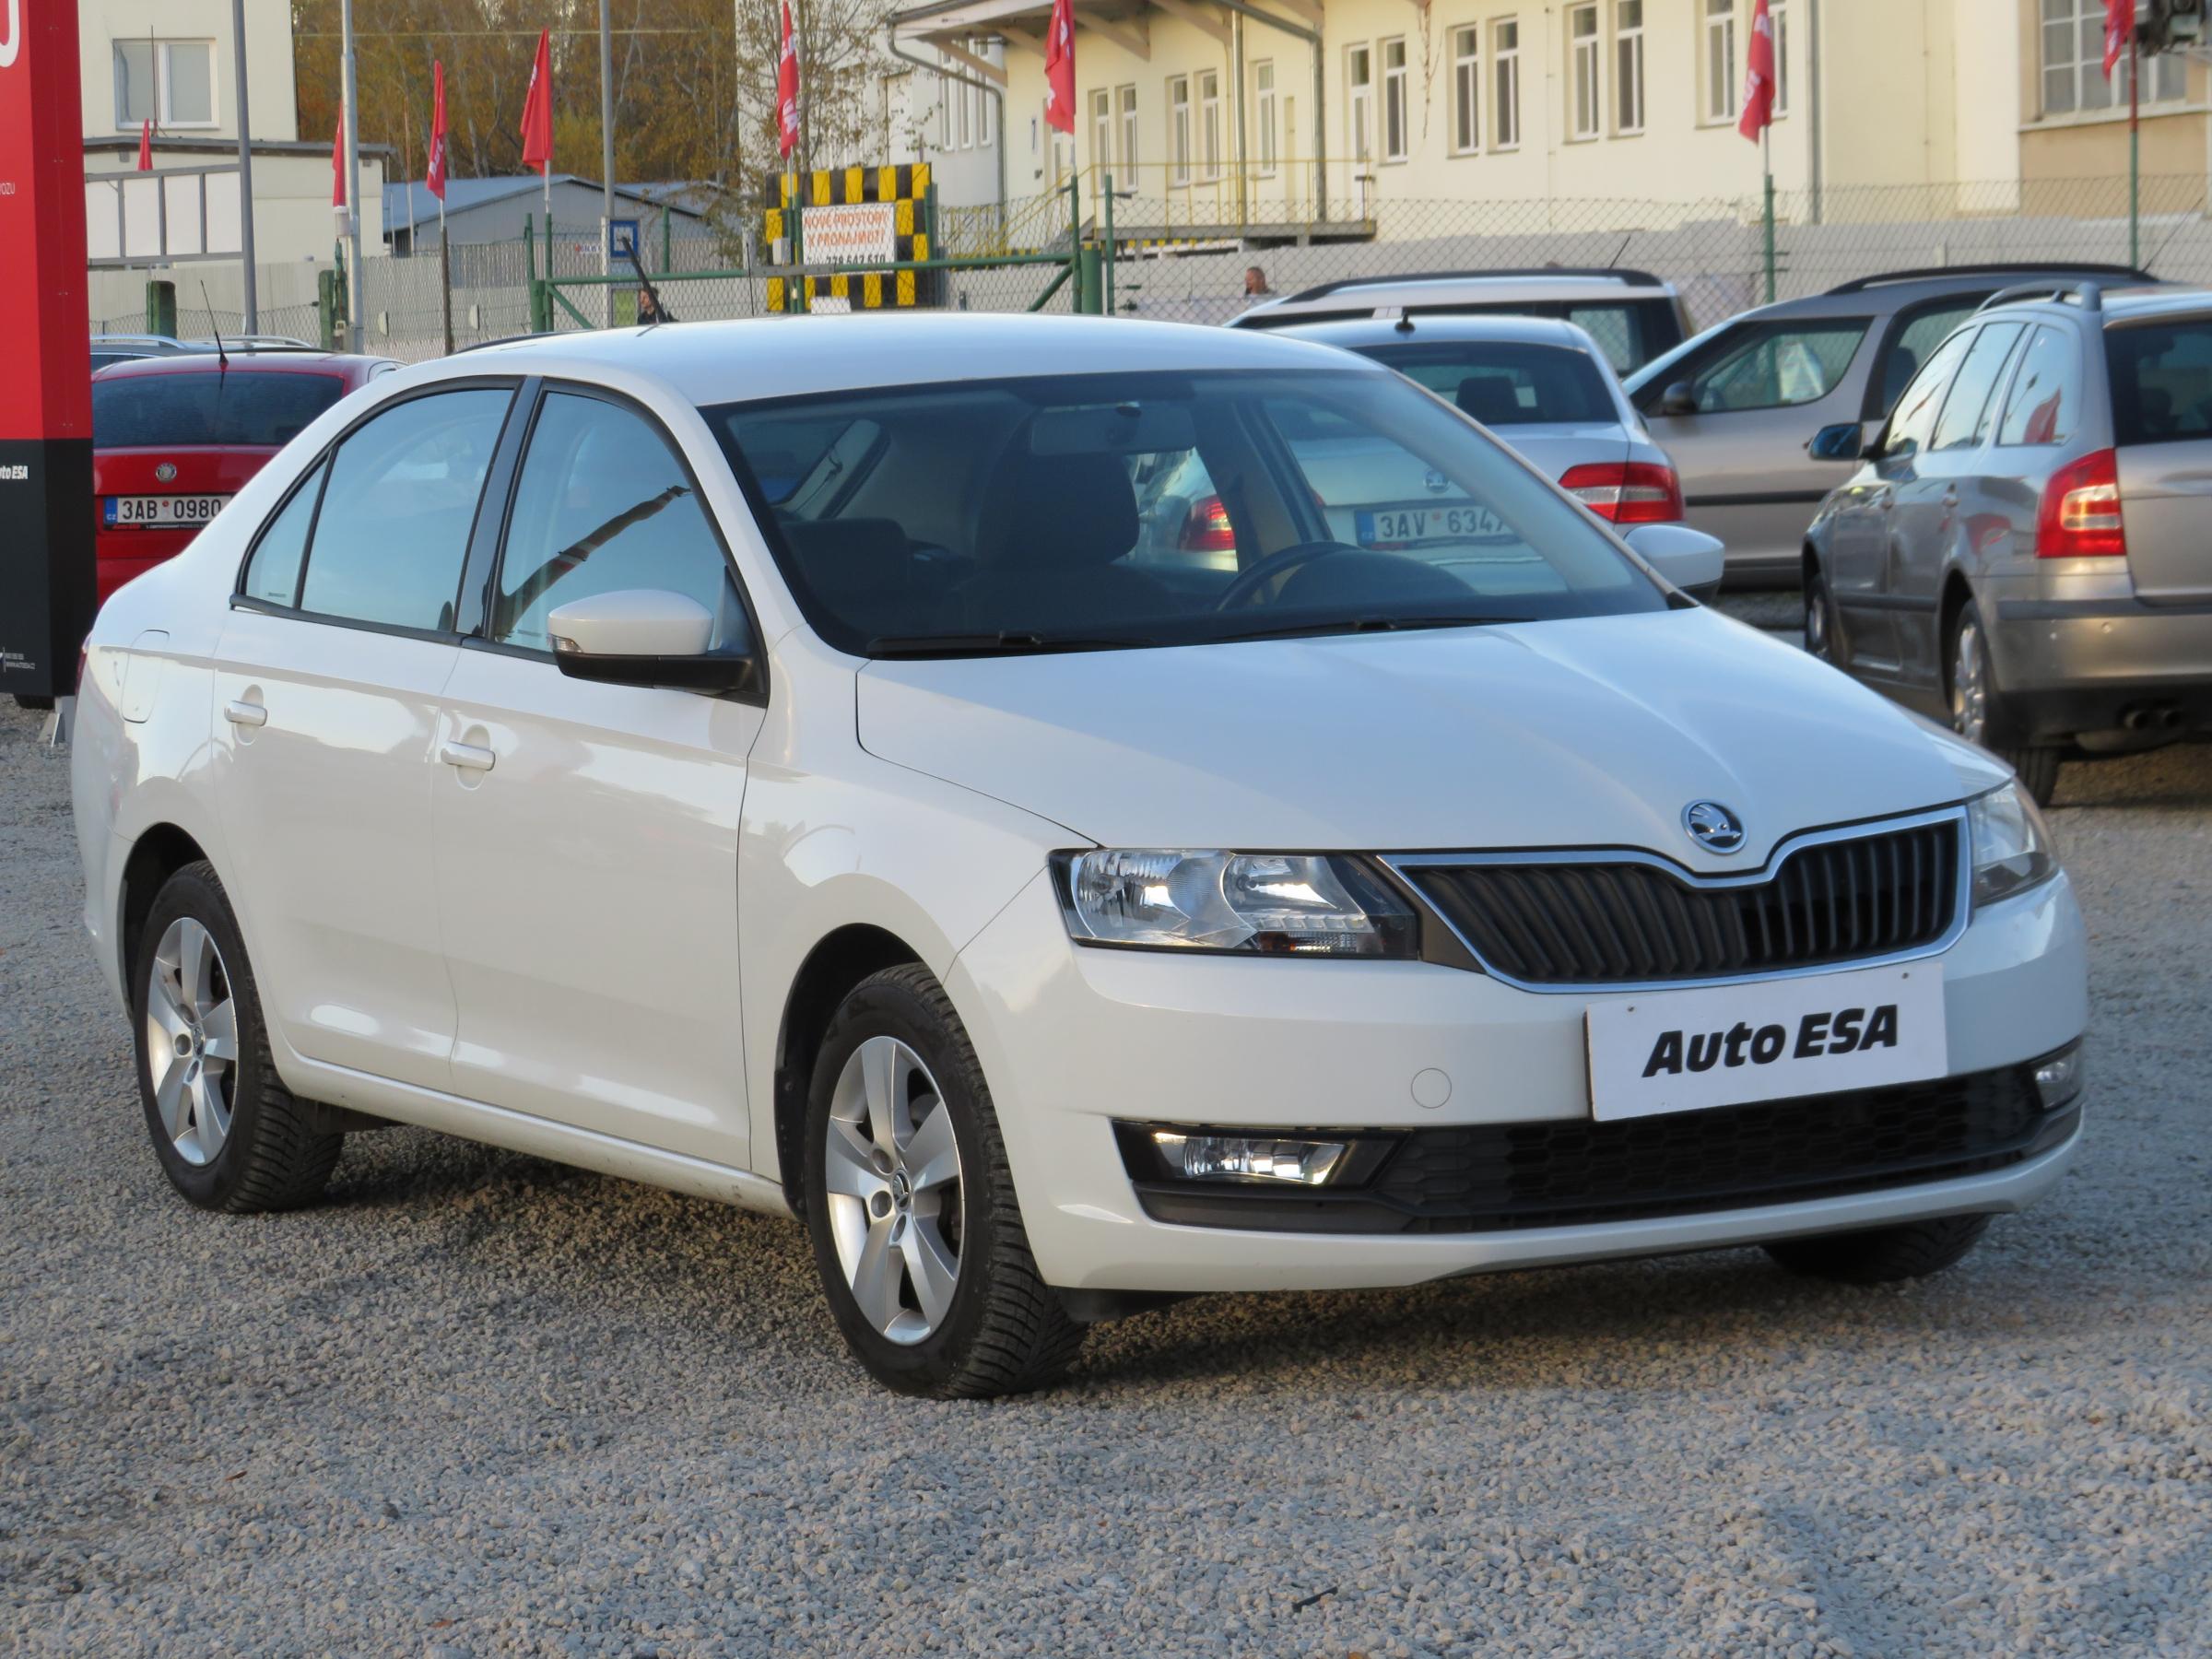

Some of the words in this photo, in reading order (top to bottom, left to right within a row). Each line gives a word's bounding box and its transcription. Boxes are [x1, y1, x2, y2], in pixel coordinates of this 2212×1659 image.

[11, 465, 29, 479] ESA
[123, 500, 158, 520] 3AB
[173, 499, 222, 519] 0980
[1380, 512, 1426, 537] 3AV
[1641, 1021, 1786, 1078] Auto
[1793, 1004, 1899, 1059] ESA
